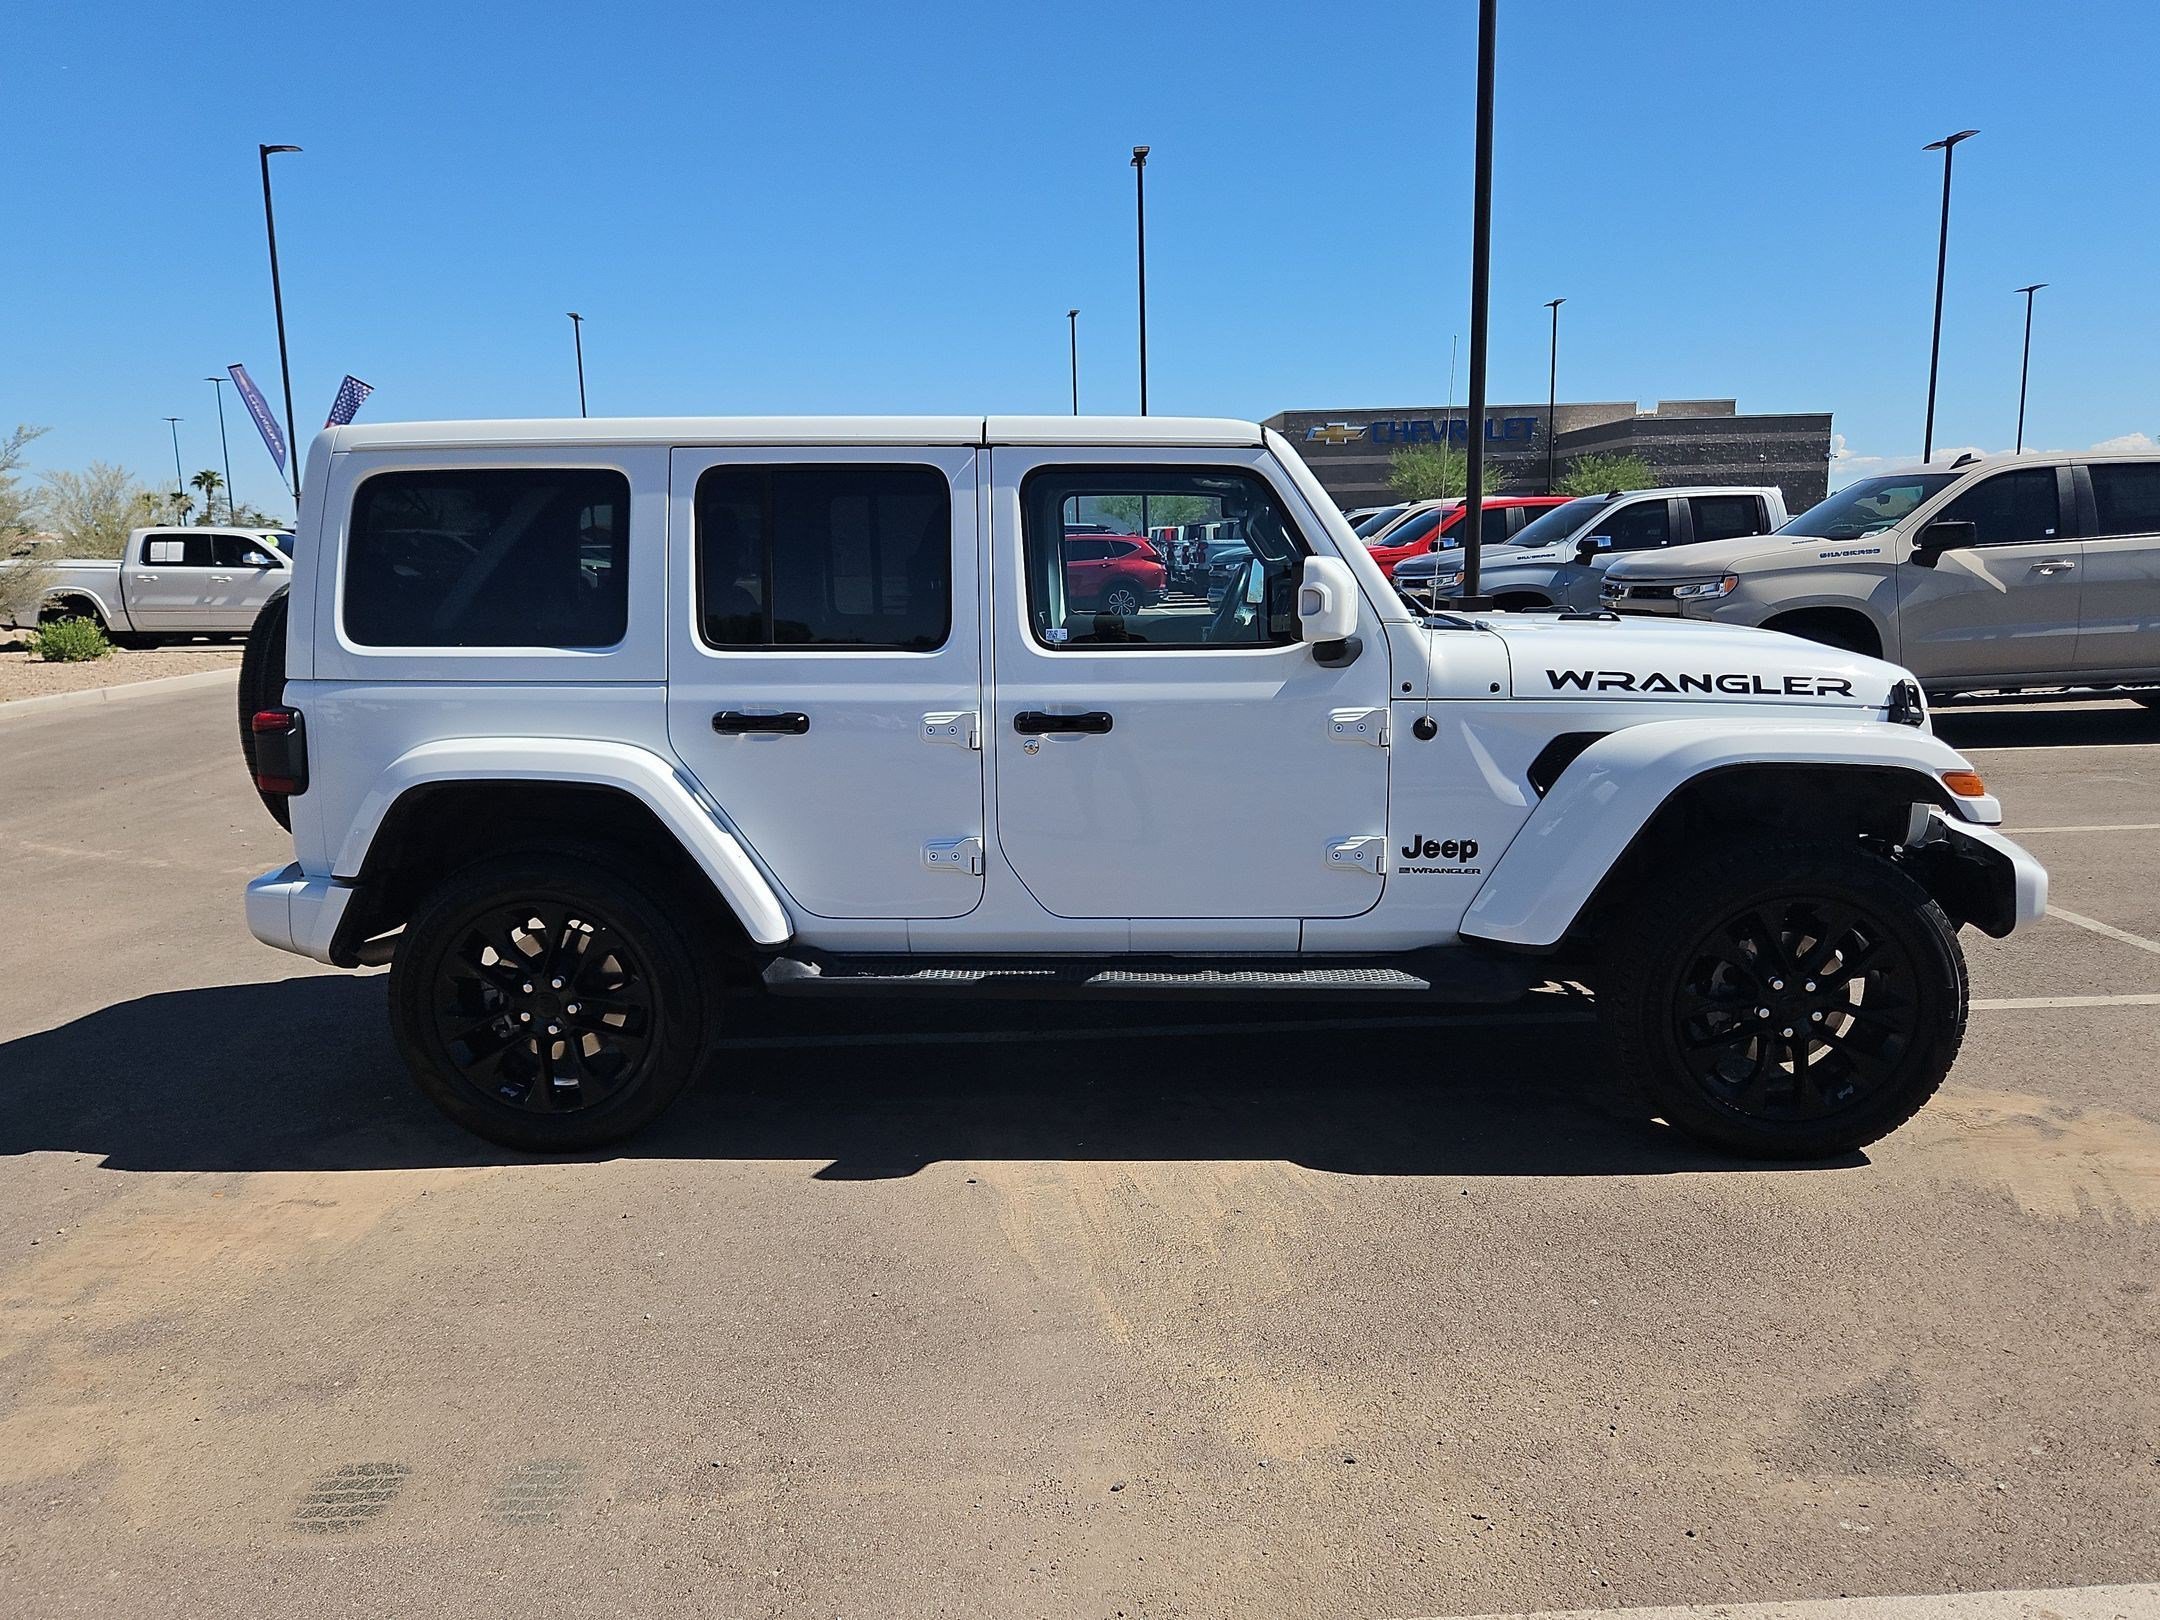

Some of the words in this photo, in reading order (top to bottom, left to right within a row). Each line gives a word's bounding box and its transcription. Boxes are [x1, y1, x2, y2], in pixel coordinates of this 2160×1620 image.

[1371, 417, 1538, 444] CHEVRLET
[1545, 669, 1856, 698] WRANGLER
[1401, 834, 1478, 863] Jeep
[1411, 867, 1481, 875] WRANGLER
